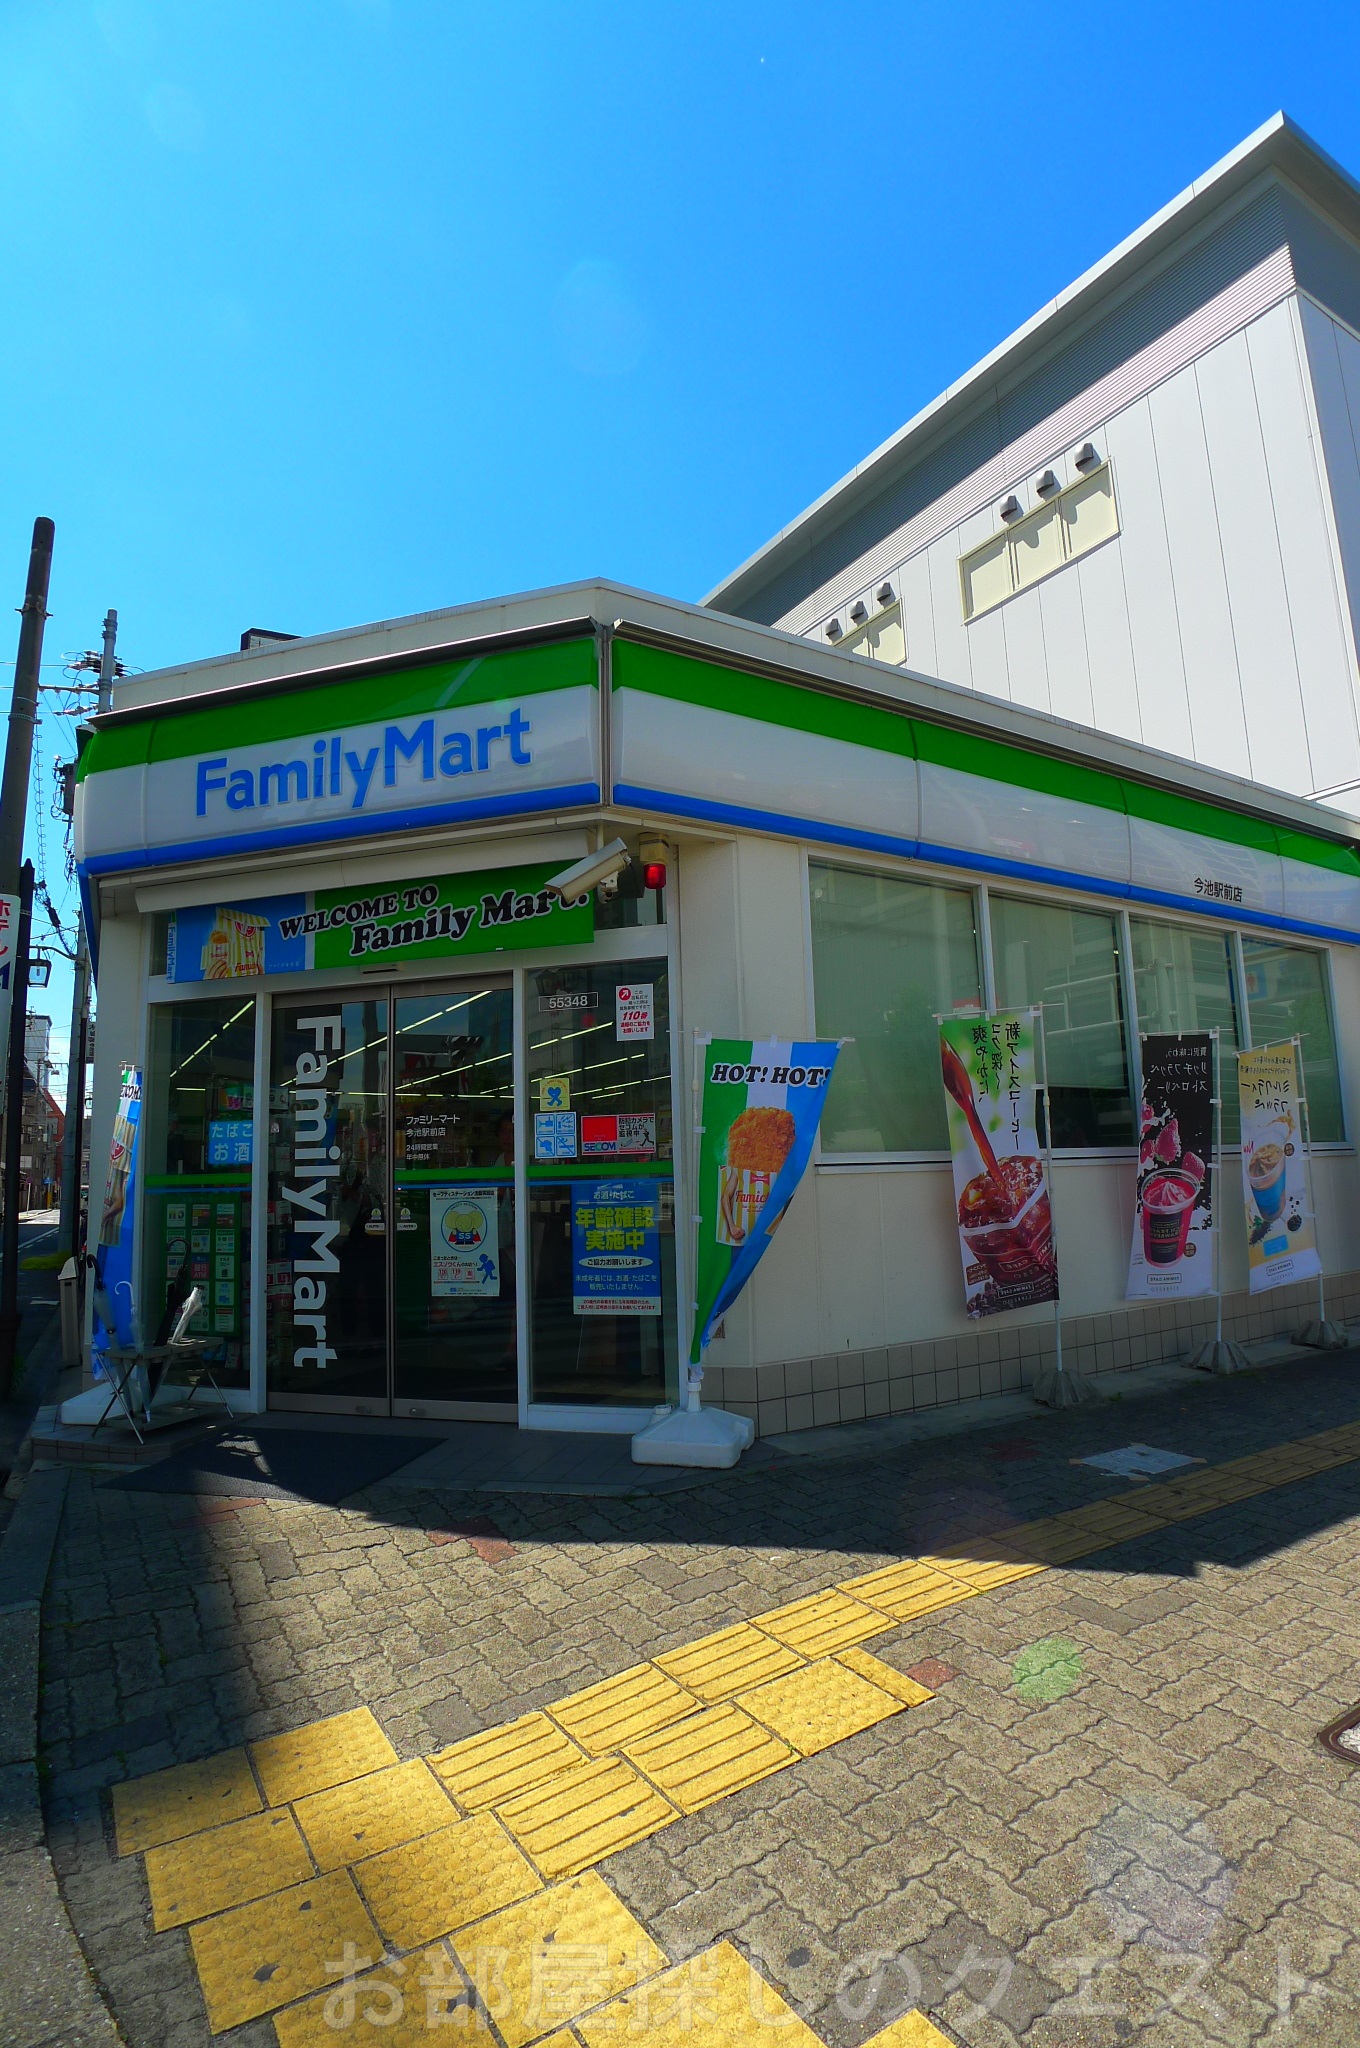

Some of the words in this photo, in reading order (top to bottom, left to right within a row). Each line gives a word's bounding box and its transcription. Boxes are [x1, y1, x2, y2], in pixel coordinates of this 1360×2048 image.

[196, 707, 532, 817] FamilyMart
[1194, 877, 1243, 903] 今池駅前店
[279, 891, 398, 939] WELCOME
[403, 883, 438, 912] TO
[350, 904, 477, 956] Family
[165, 926, 176, 981] FamilyMart
[549, 996, 588, 1009] 55348
[711, 1063, 769, 1084] HOT!
[405, 1113, 461, 1125] ファミリーマート
[211, 1123, 253, 1139] たばこ
[405, 1127, 447, 1138] 今池駅前店
[213, 1143, 250, 1162] お酒
[584, 1142, 616, 1152] SECOM
[281, 1015, 342, 1369] FamilyMart
[735, 1190, 770, 1203] Famic
[575, 1206, 655, 1229] 年齢確認
[459, 1232, 471, 1240] SS
[586, 1229, 645, 1251] 実施中
